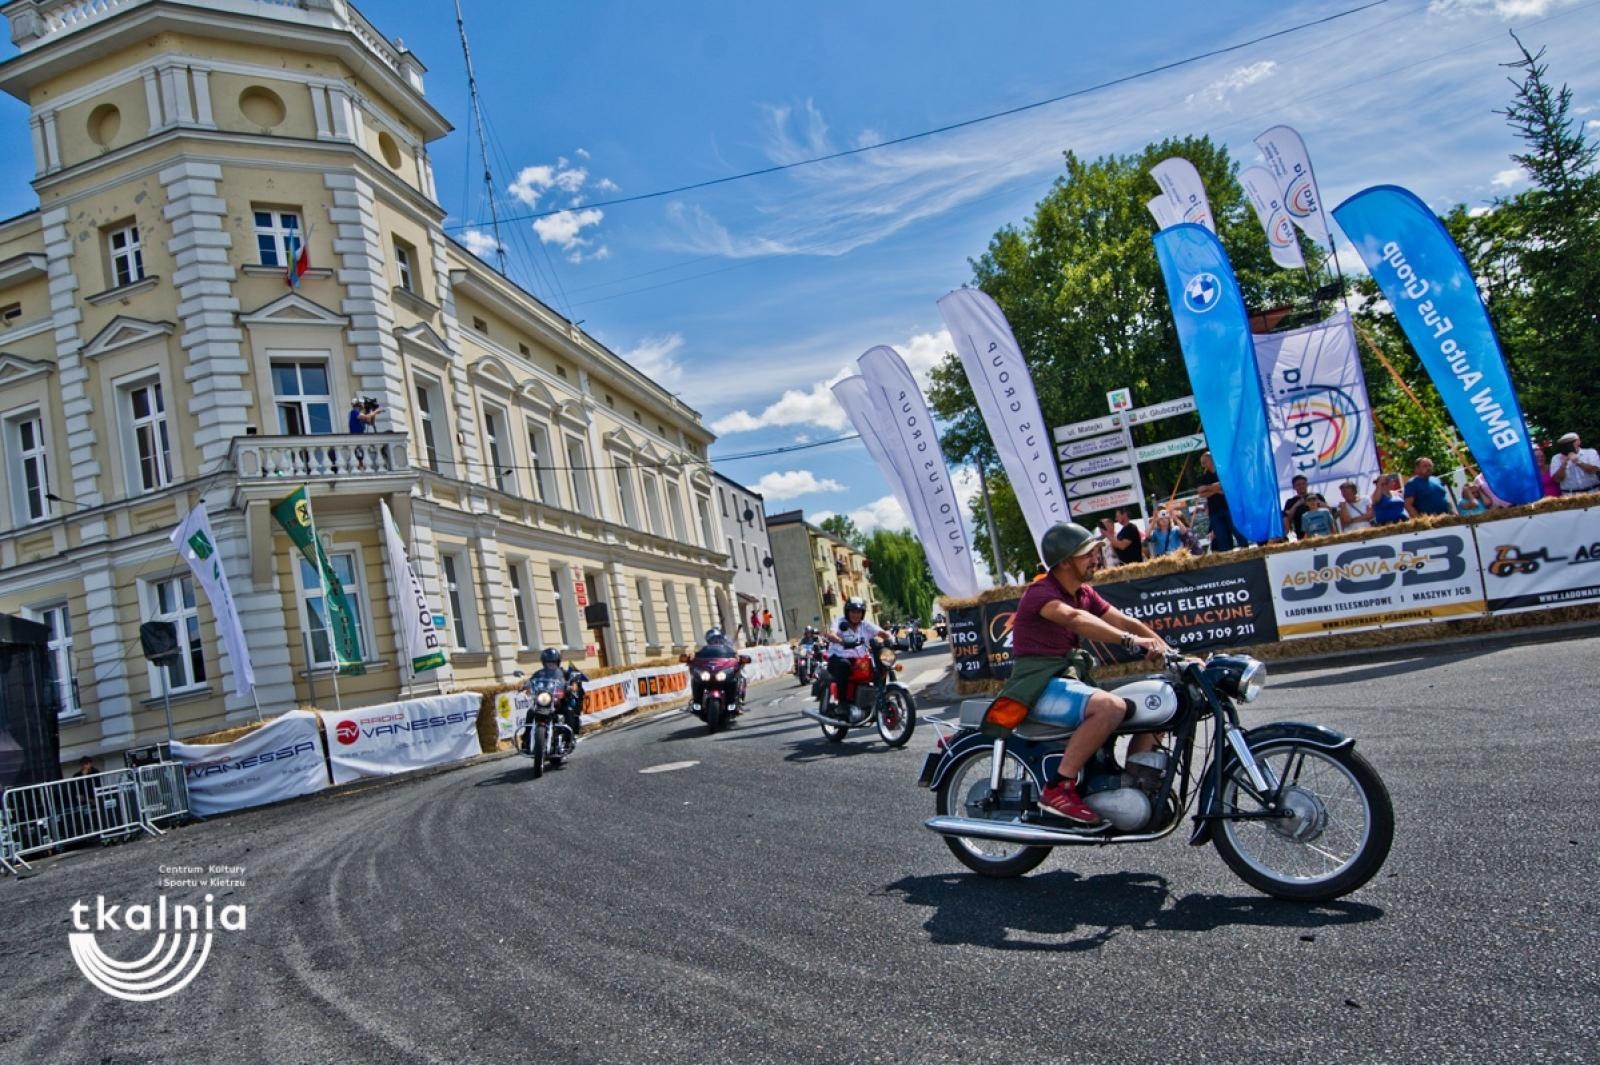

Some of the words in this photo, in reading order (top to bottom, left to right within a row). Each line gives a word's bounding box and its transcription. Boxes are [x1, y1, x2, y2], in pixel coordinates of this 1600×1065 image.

[1138, 412, 1148, 420] ul.
[1066, 429, 1075, 437] ul.
[1078, 422, 1103, 434] Matejki
[1138, 447, 1168, 458] Stadion
[1168, 440, 1194, 452] Miejski
[1091, 478, 1121, 489] Policja
[1281, 535, 1466, 602] JCB
[1281, 559, 1390, 587] AGRONOVA
[1178, 589, 1250, 612] ELEKTRO
[1284, 604, 1333, 618] ŁADOWARKI
[1334, 596, 1393, 611] TELESKOPOWE
[1412, 589, 1452, 601] MASZYNY
[1455, 586, 1472, 595] JCB
[1143, 605, 1254, 630] NSTALACYJNE
[1180, 632, 1204, 644] 693
[1207, 627, 1231, 639] 709
[1236, 623, 1255, 635] 211
[193, 741, 316, 778] VANESSA
